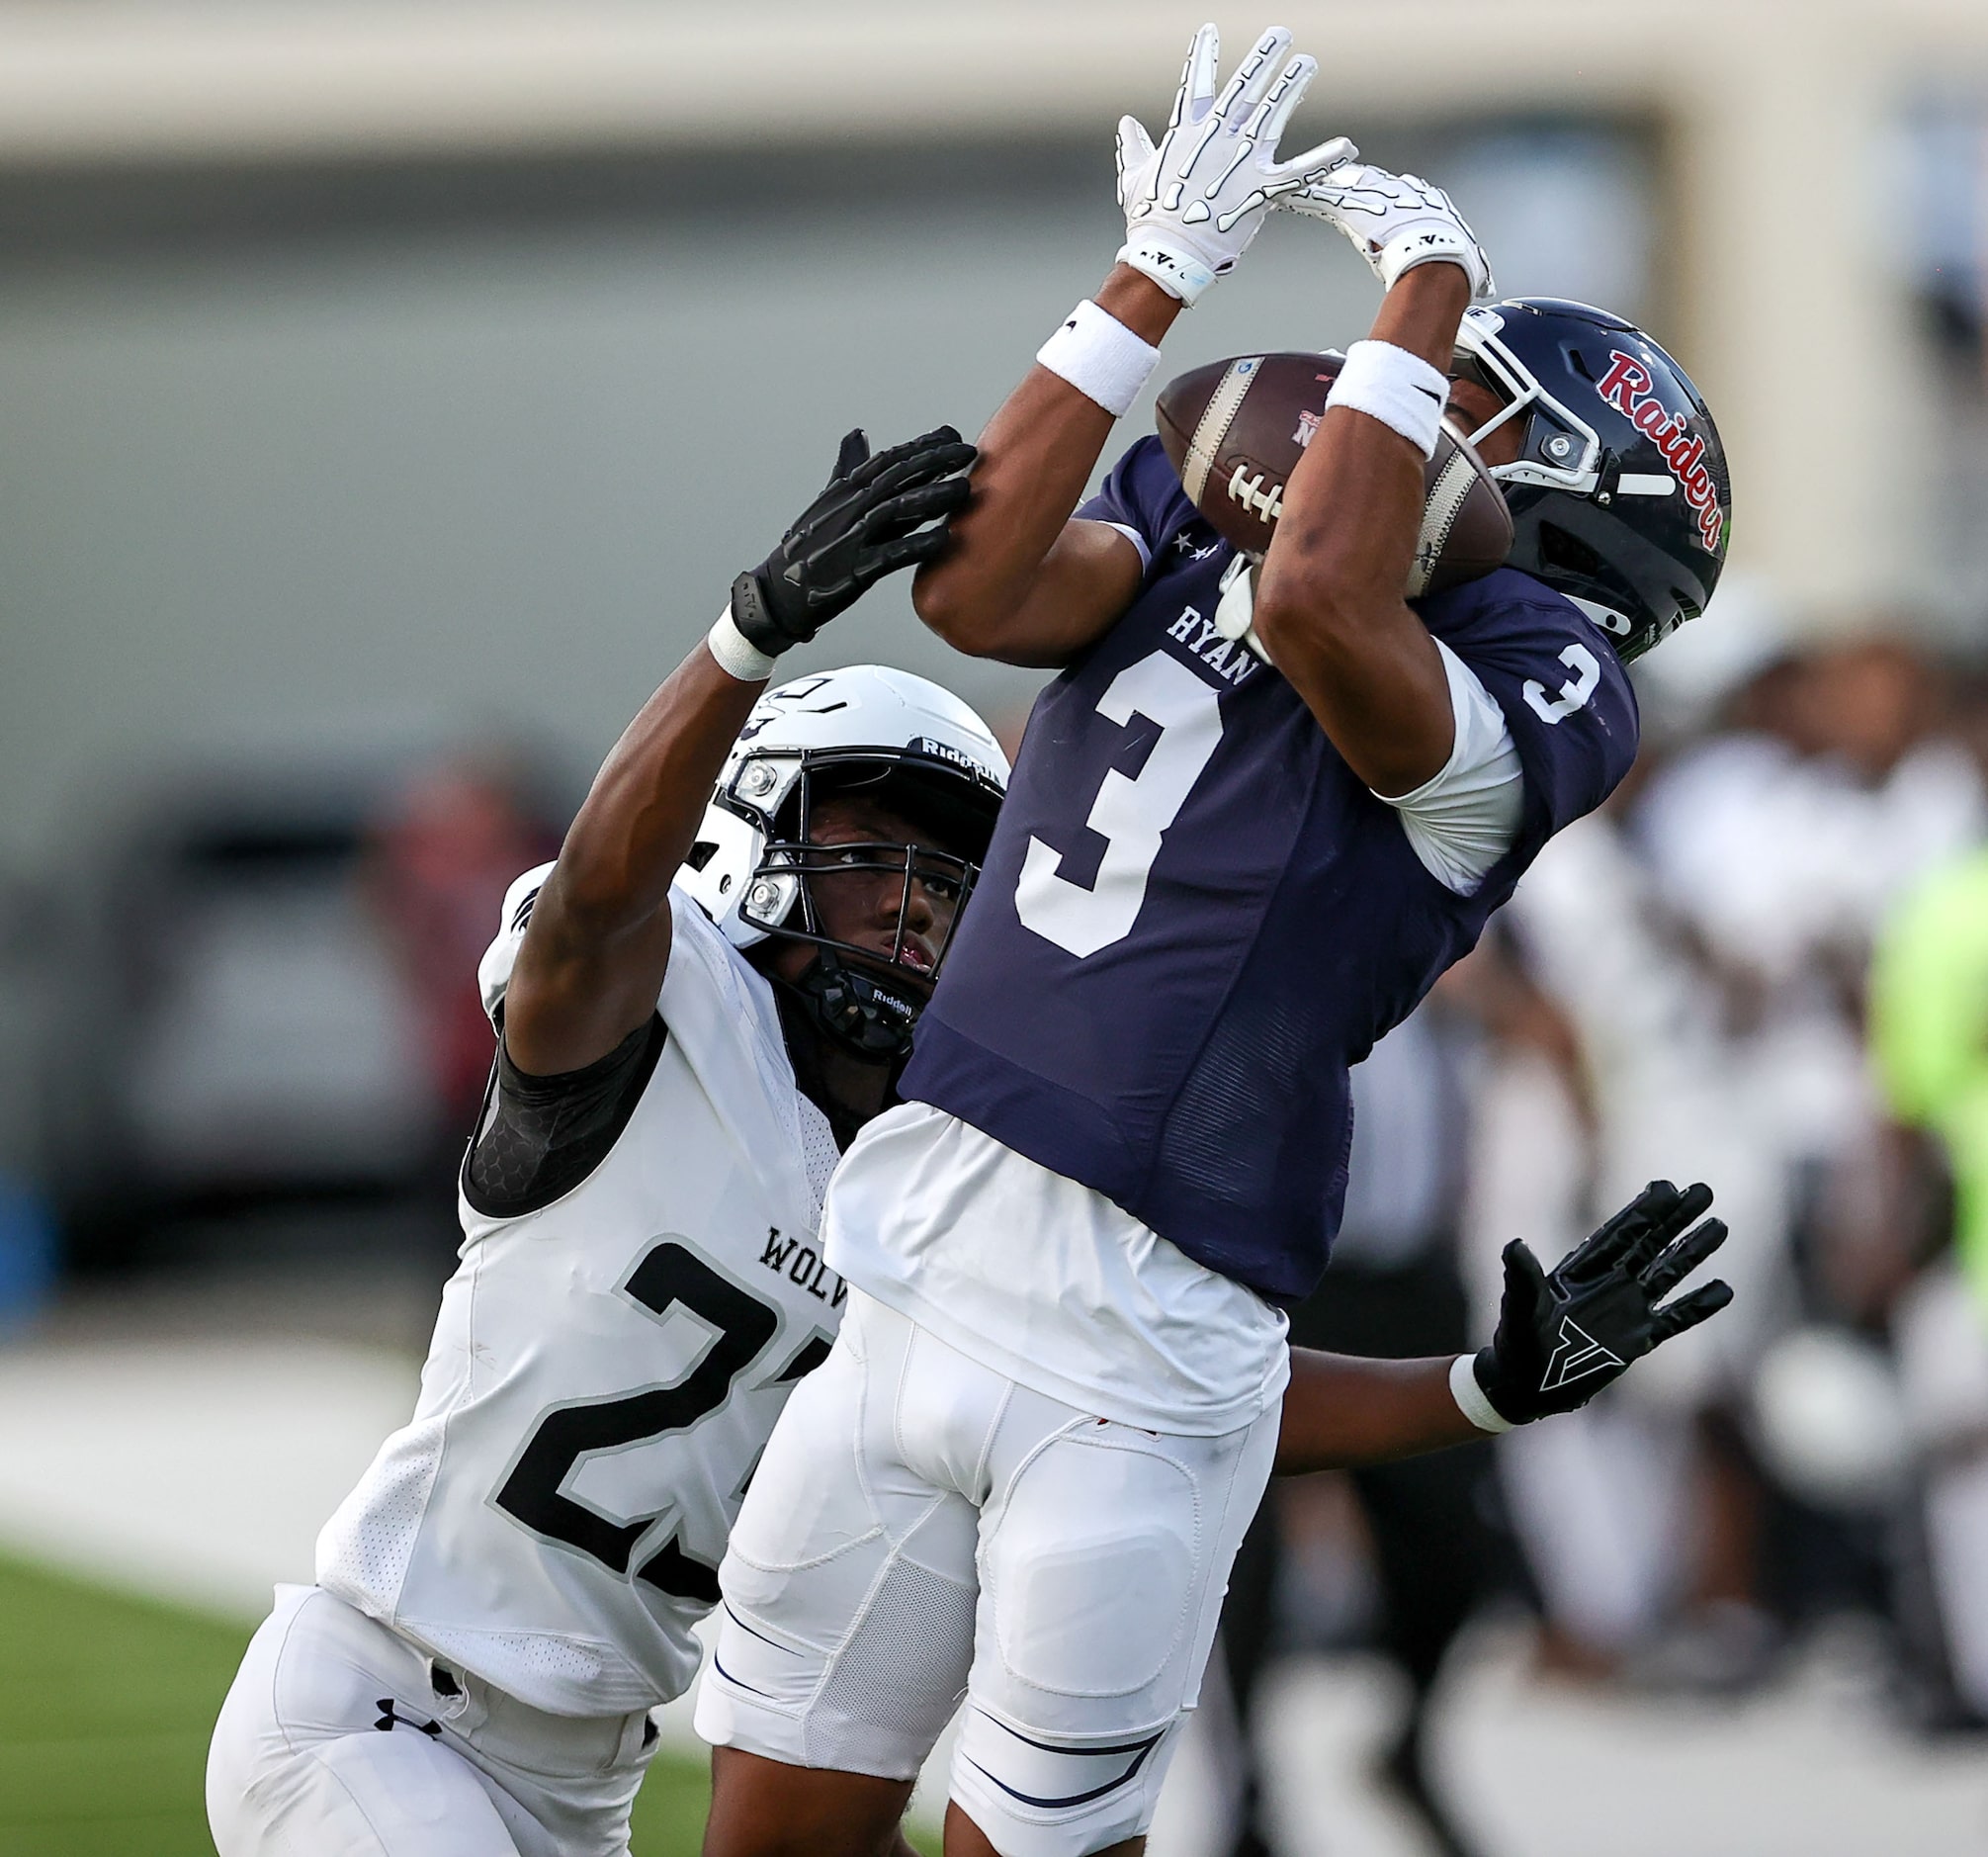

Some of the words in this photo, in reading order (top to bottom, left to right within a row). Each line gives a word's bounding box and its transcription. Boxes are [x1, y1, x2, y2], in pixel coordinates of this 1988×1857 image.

[1166, 605, 1259, 685] RYAN
[1522, 643, 1601, 725] 3
[1014, 649, 1225, 959] 3
